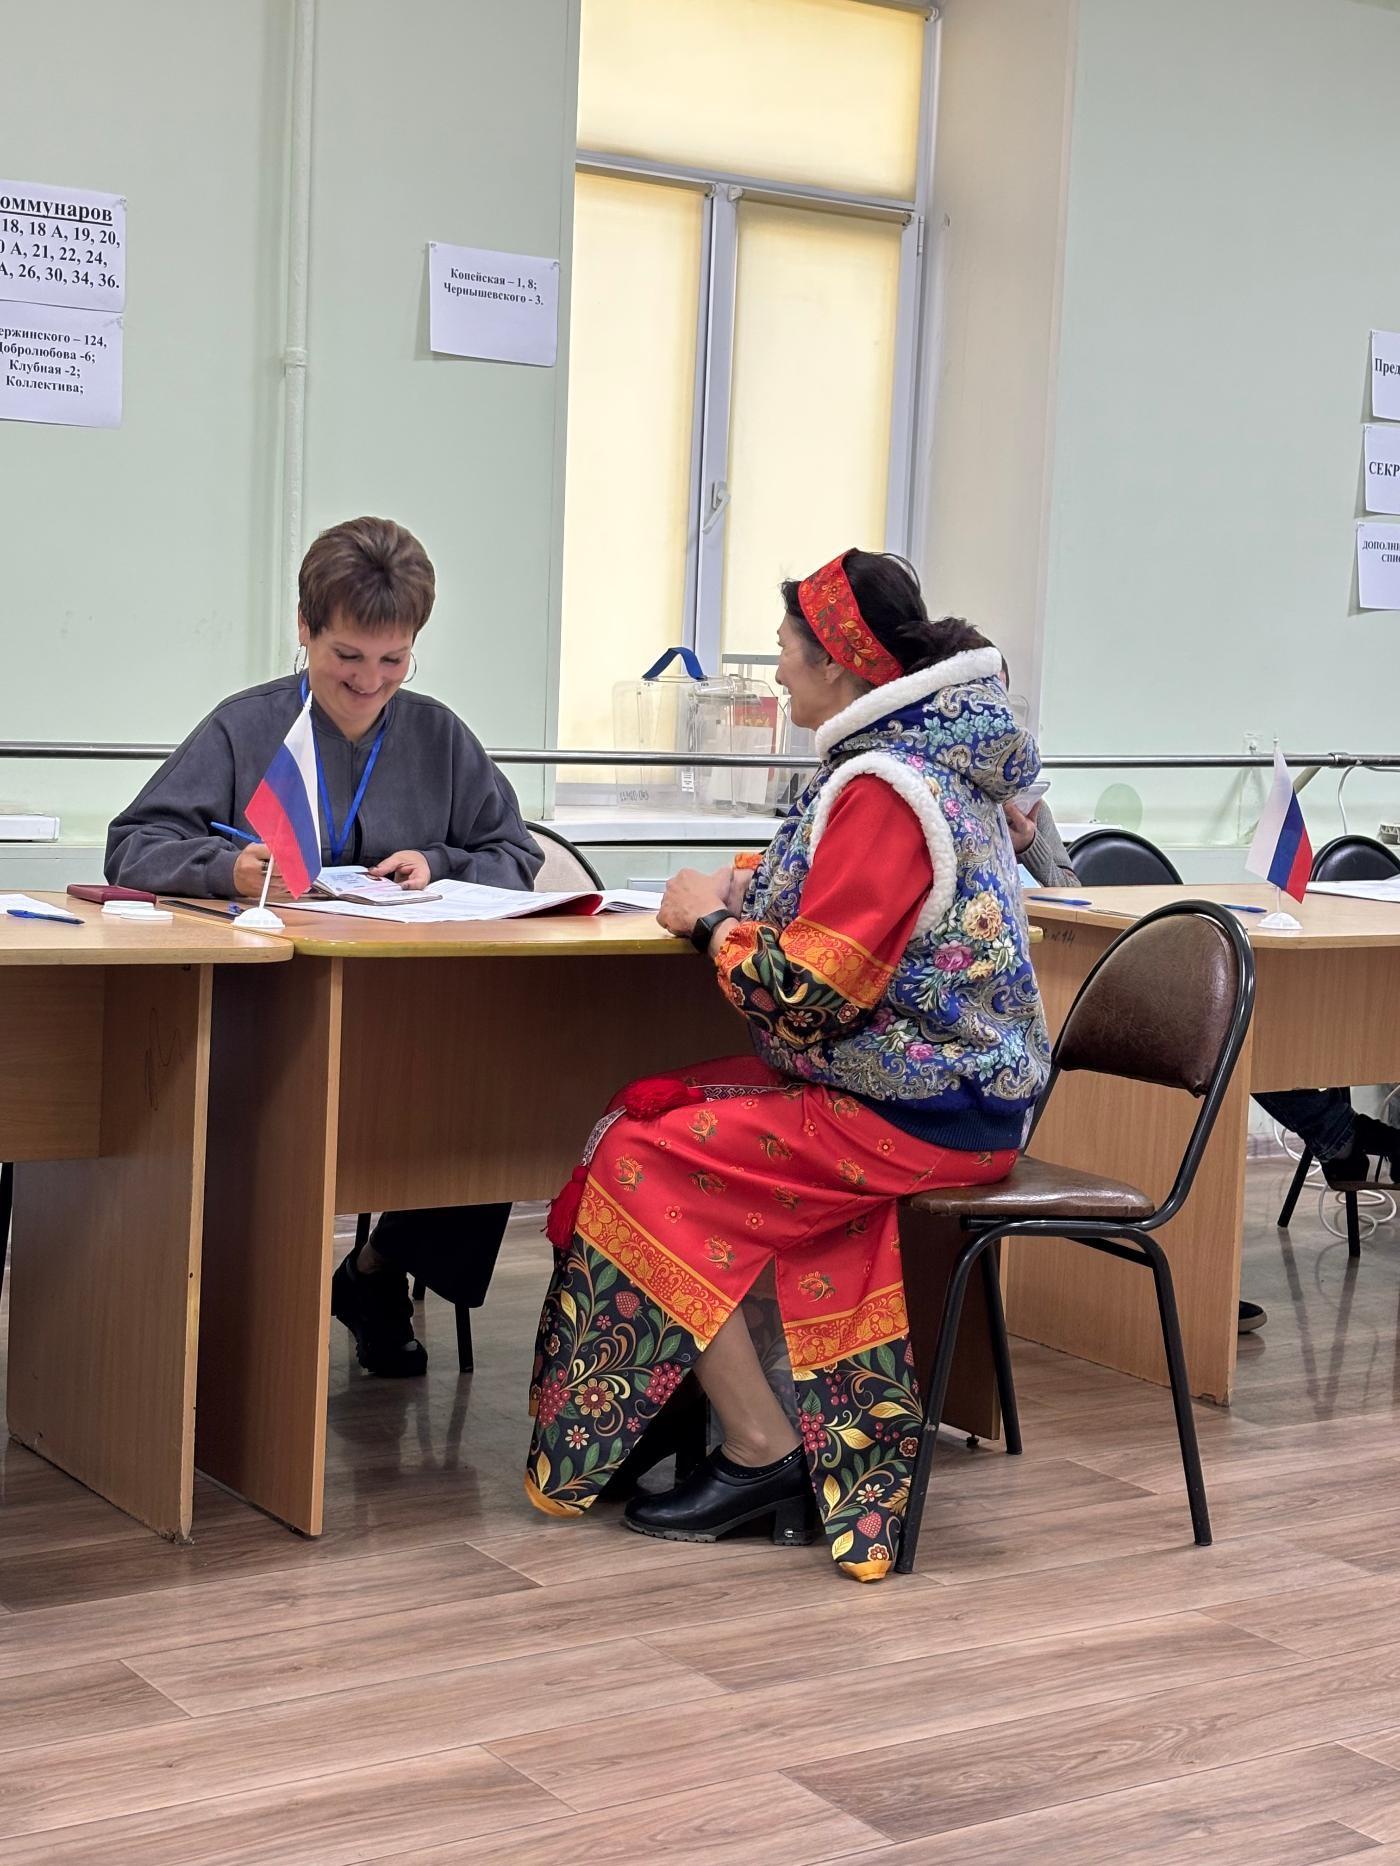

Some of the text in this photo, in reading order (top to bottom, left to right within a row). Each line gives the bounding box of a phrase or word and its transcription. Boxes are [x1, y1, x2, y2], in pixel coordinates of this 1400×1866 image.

[0, 196, 113, 222] оммунаров
[2, 218, 121, 248] 18, 18 А, 19, 20,
[10, 241, 27, 259] А,
[32, 243, 55, 262] 21,
[59, 246, 81, 266] 22,
[86, 250, 108, 268] 24,
[18, 264, 41, 282] 26,
[44, 266, 68, 286] 30,
[71, 270, 94, 289] 34,
[98, 273, 120, 289] 36.
[450, 267, 506, 286] Копейская
[443, 282, 527, 303] Чернышевского
[9, 359, 62, 375] Клубная
[6, 375, 84, 394] Коллектива;
[1368, 461, 1400, 477] СЕКР
